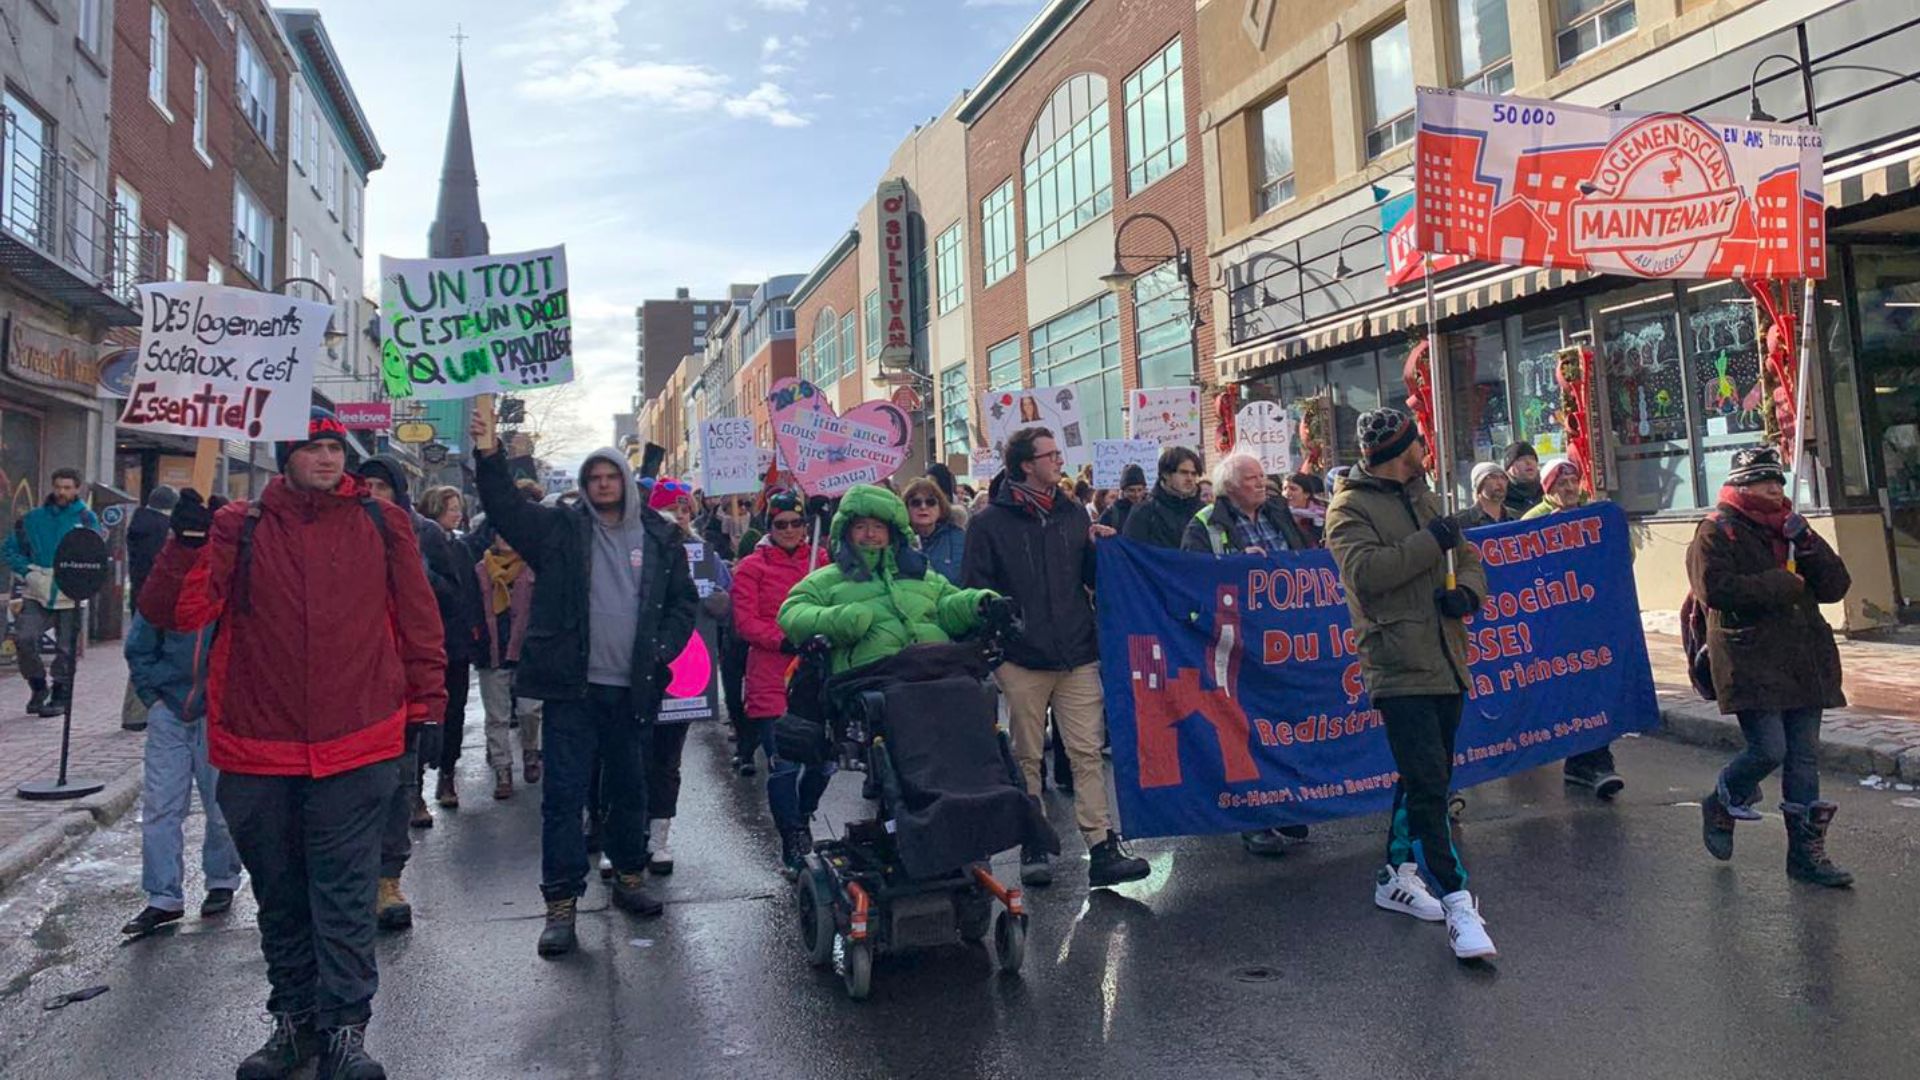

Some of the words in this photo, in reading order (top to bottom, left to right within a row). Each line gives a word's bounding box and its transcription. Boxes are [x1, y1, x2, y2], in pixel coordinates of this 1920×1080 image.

[1724, 128, 1738, 143] EN
[1602, 123, 1682, 196] LOGEMEN
[399, 270, 466, 313] UN
[473, 255, 553, 298] TOIT
[1635, 254, 1652, 268] AU
[192, 296, 302, 345] logements
[393, 315, 468, 349] C'EST
[474, 302, 511, 333] UN
[246, 346, 299, 383] c'est
[445, 347, 490, 383] UN
[123, 381, 272, 439] Essentiel!
[781, 423, 817, 441] nous
[1483, 570, 1596, 622] social,
[1263, 629, 1319, 665] Du
[1499, 645, 1613, 692] richesse
